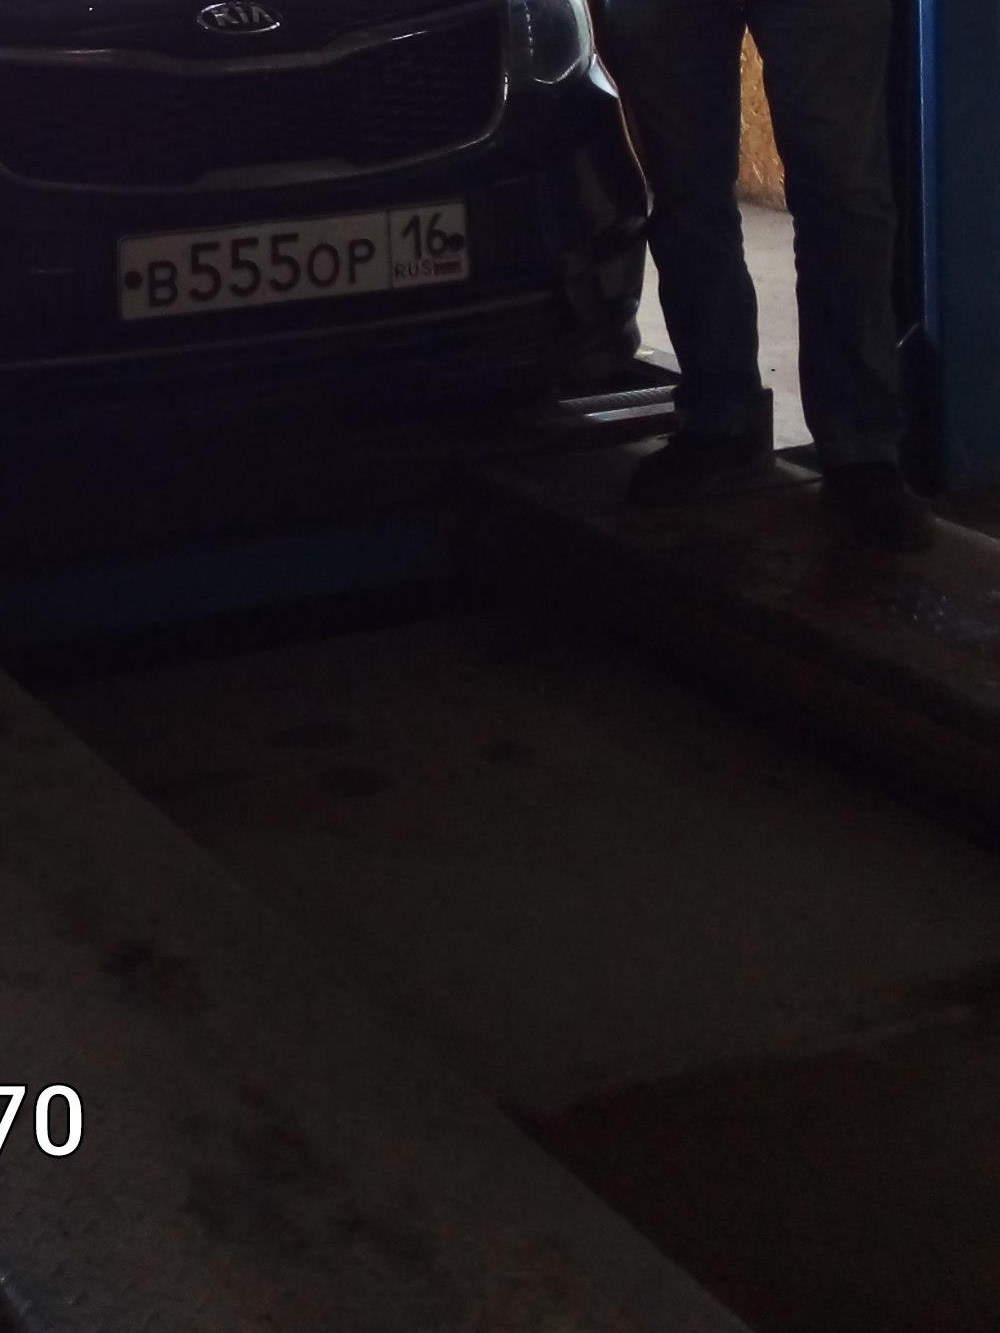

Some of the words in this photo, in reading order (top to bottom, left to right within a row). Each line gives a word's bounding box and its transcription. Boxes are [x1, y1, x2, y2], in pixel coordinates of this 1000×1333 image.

[211, 6, 275, 26] KIA
[402, 212, 449, 261] 16
[394, 259, 433, 279] RUS
